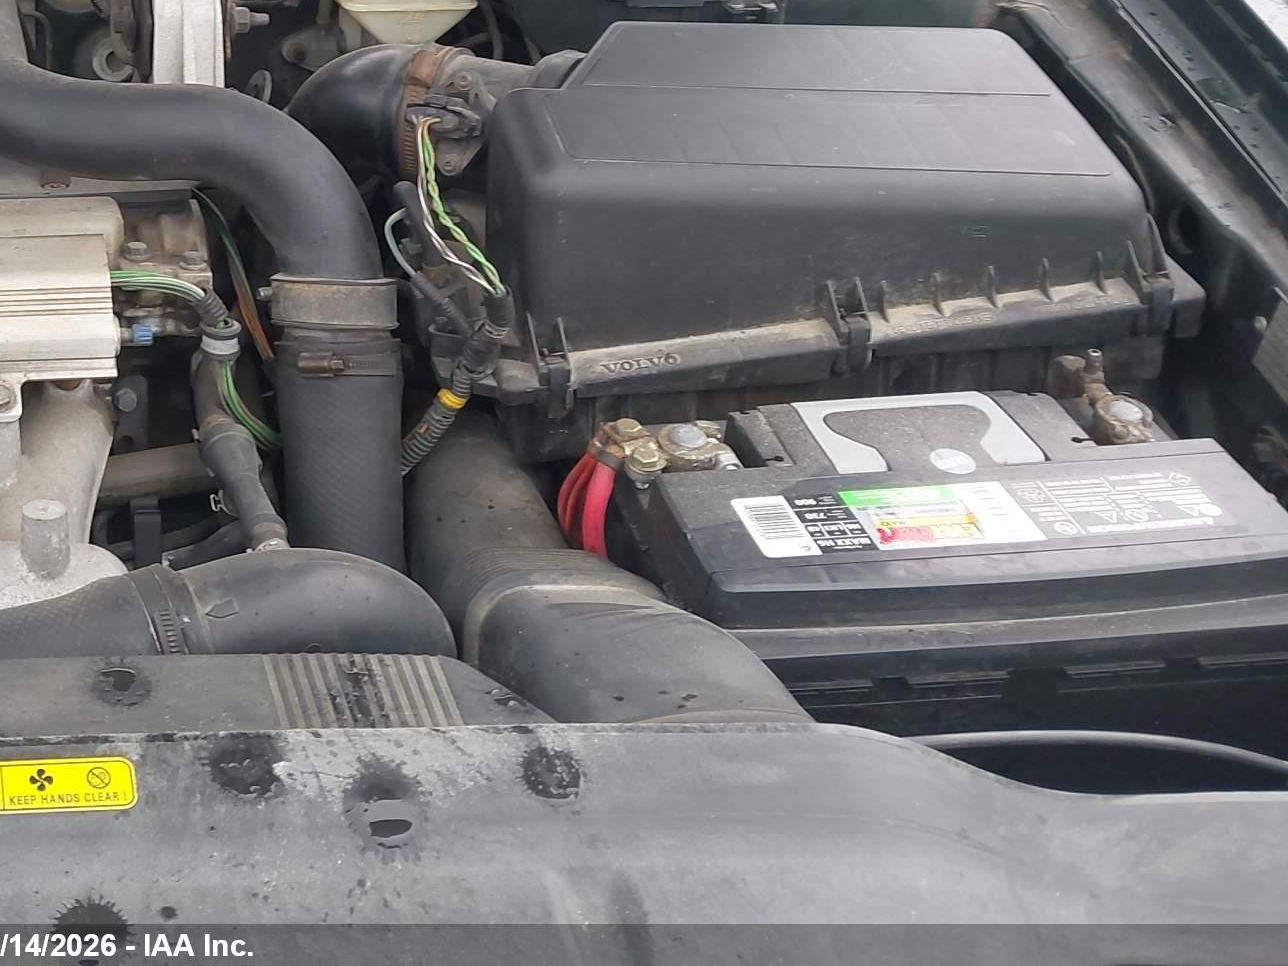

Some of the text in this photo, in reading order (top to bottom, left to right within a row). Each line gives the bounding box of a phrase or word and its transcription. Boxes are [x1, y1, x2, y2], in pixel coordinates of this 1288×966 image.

[600, 352, 679, 374] VOLVO
[9, 795, 37, 806] KEEP
[41, 793, 81, 805] HANDS
[85, 791, 120, 803] CLEAR
